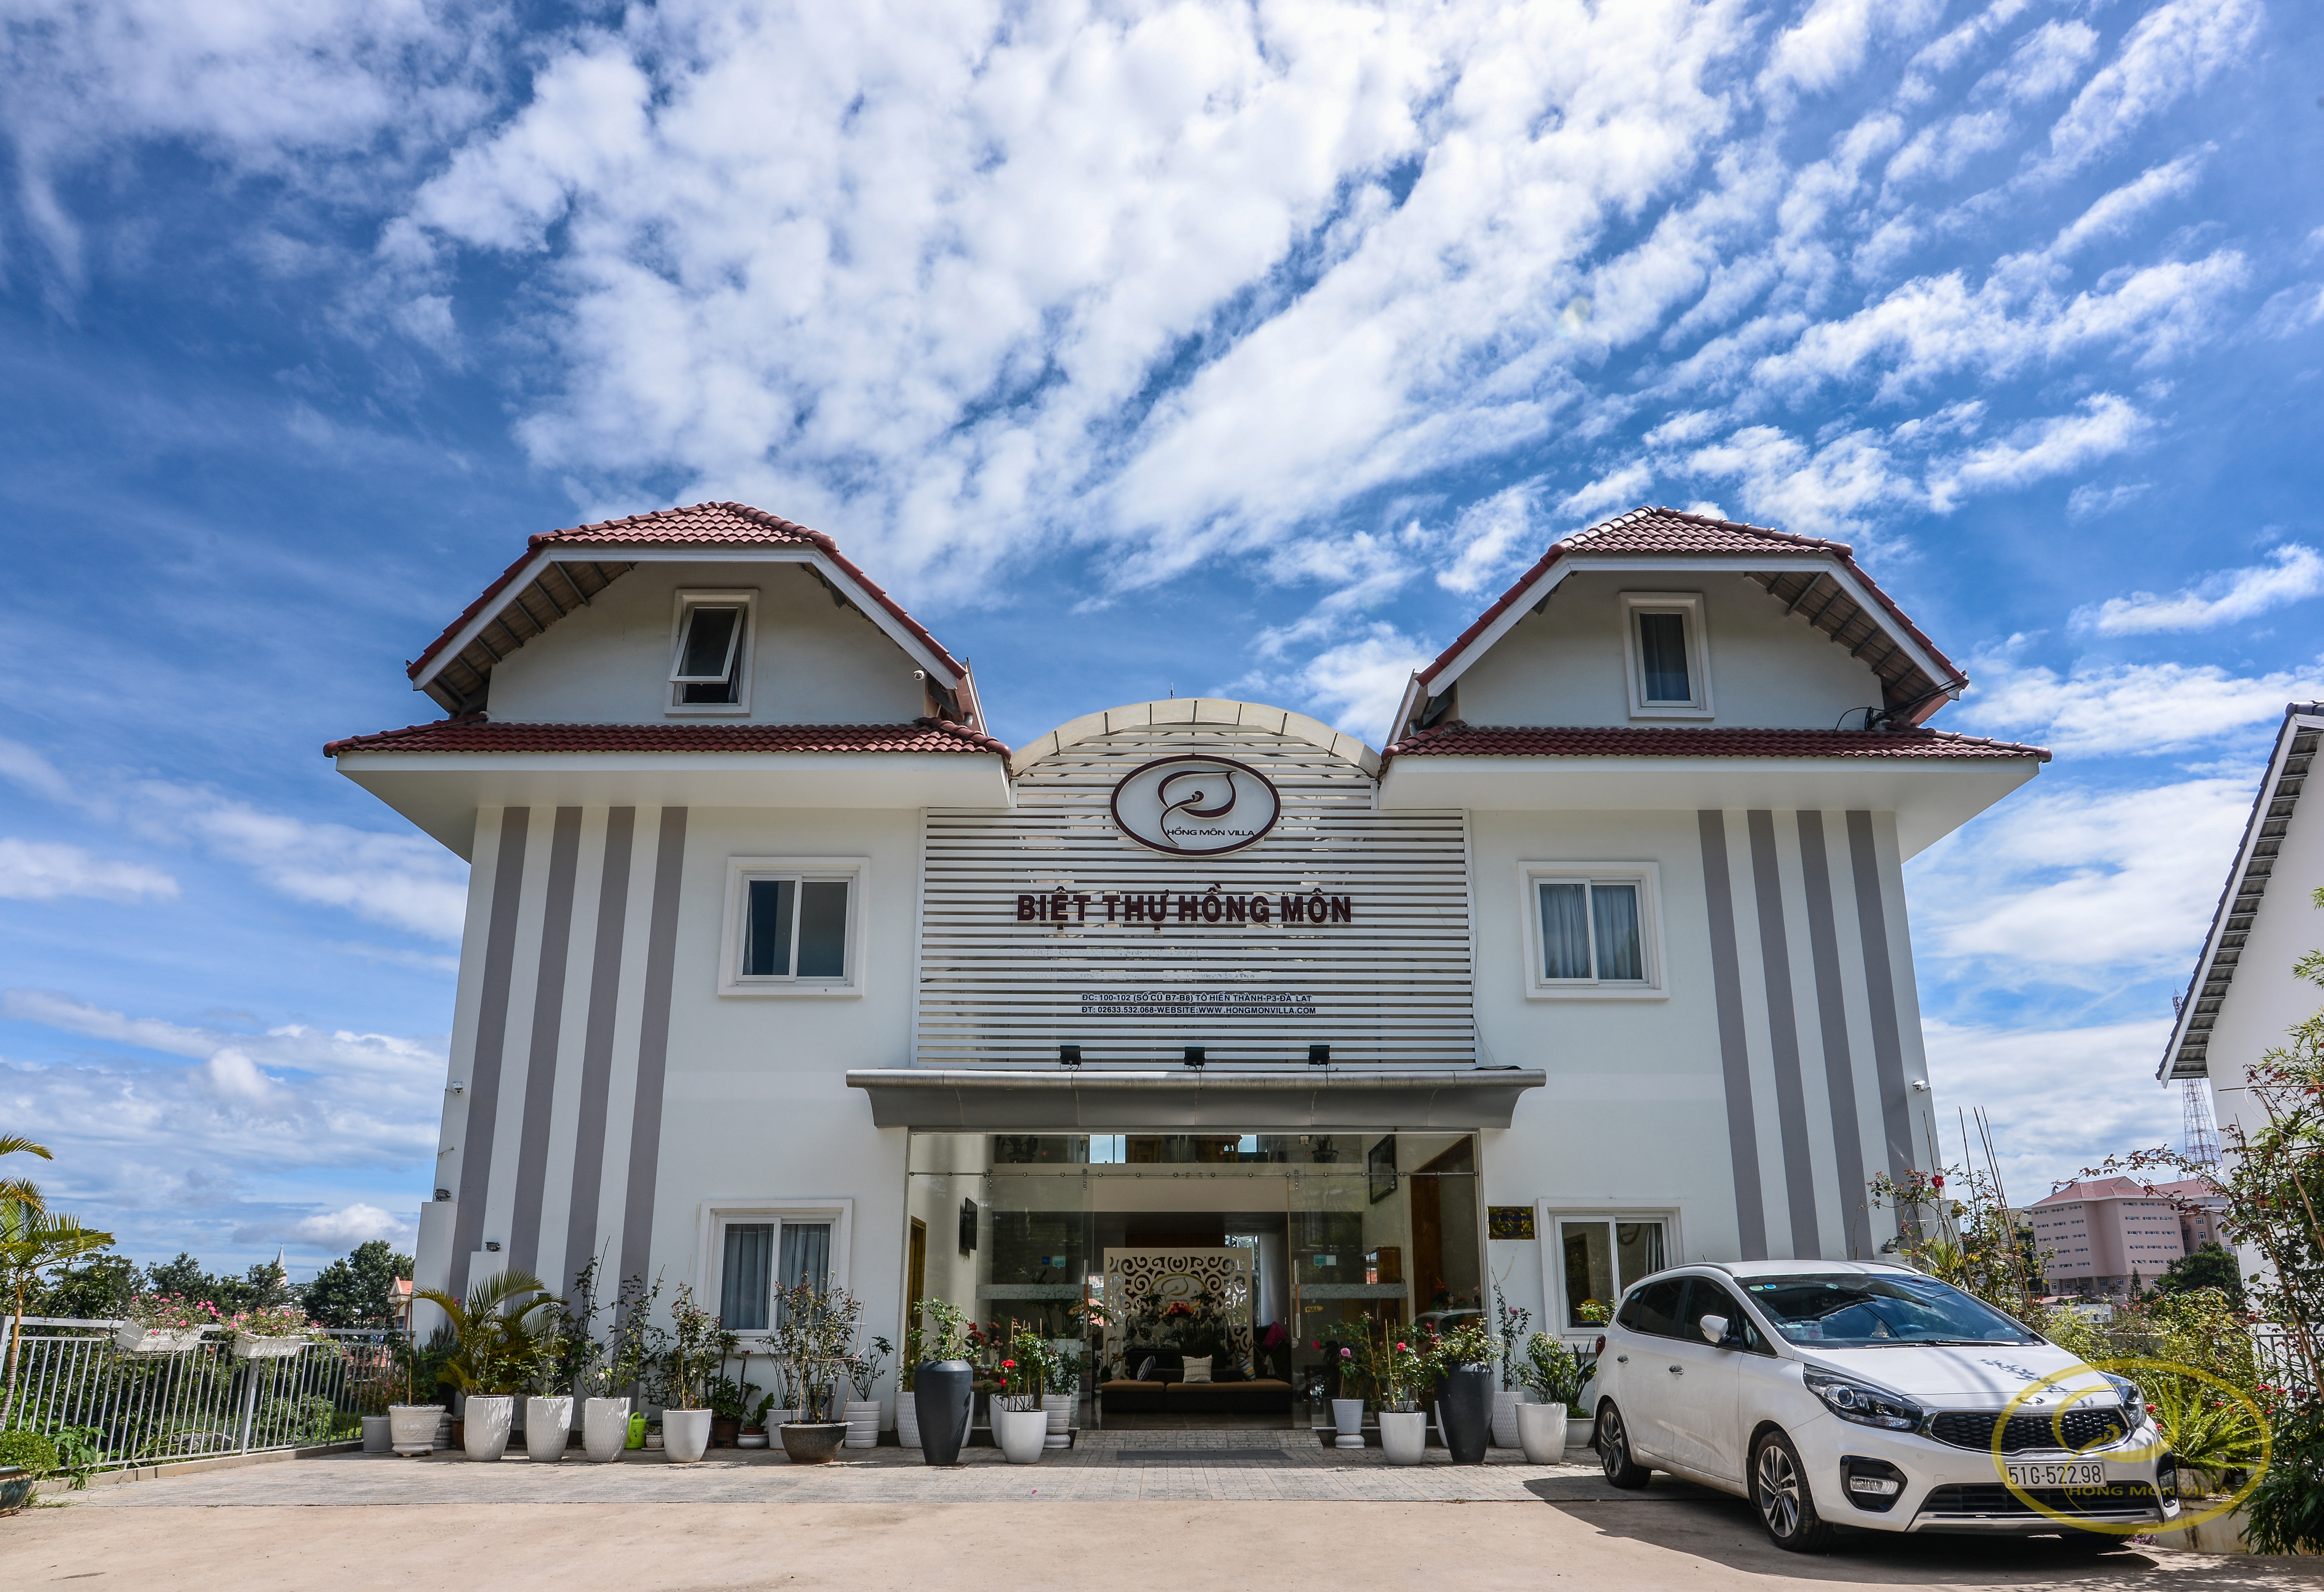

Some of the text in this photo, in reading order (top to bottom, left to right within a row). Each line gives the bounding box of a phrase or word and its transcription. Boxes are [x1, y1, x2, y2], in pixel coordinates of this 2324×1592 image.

[1167, 826, 1197, 836] HỒNG
[1017, 883, 1352, 933] BIỆT THỰ HỒNG MÔN
[1133, 991, 1150, 1003] (SỐ
[1150, 992, 1163, 1001] CŨ
[1165, 994, 1194, 1003] B7-B8)
[1195, 993, 1208, 1001] TÔ
[1296, 995, 1312, 1004] LẠT
[2008, 1465, 2102, 1485] 51G-522.98
